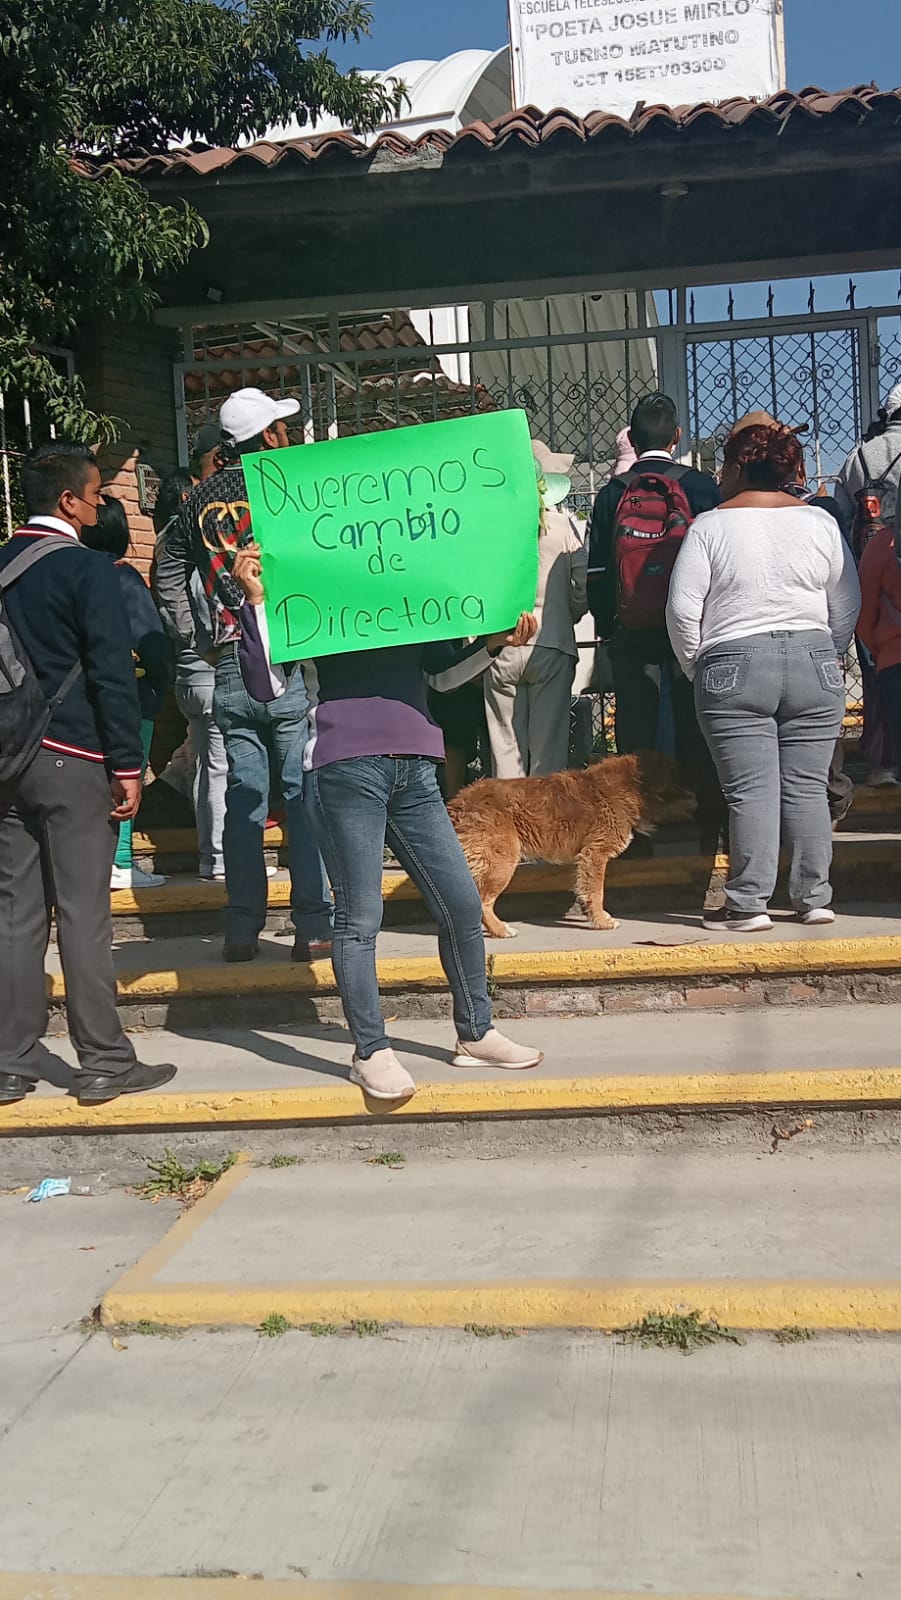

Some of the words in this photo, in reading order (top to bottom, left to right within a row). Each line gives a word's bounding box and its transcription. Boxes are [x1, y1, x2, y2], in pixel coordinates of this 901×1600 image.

[519, 0, 571, 15] ESCUELA
[608, 7, 678, 33] JOSUE
[550, 44, 624, 67] TURNO
[630, 29, 740, 57] MATUTINO
[573, 71, 609, 88] CCT
[311, 502, 461, 550] Cambio
[367, 545, 406, 575] de
[275, 593, 485, 649] Directora
